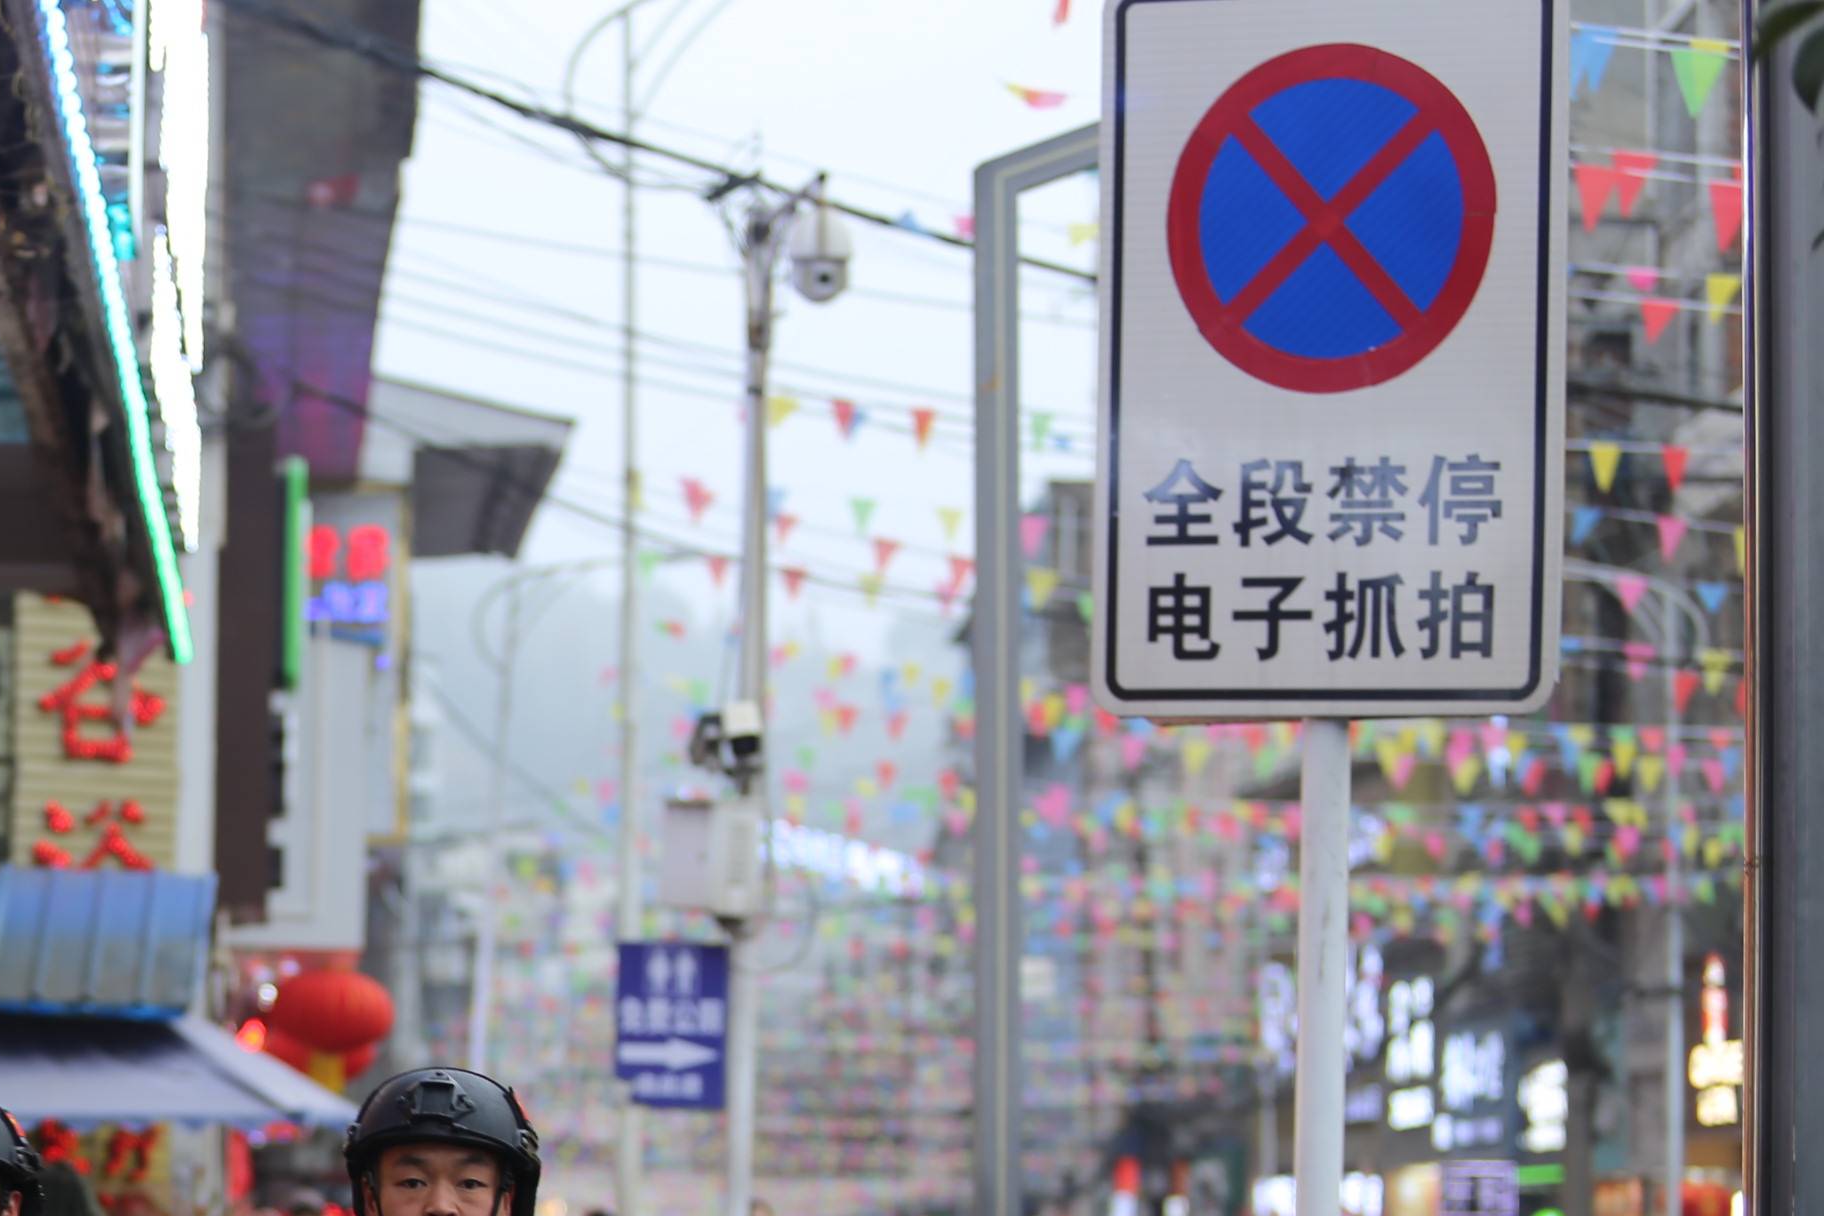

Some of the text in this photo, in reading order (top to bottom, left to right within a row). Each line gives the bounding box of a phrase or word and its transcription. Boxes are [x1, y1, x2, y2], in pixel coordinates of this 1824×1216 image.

[1143, 454, 1502, 546] 全段禁停
[1146, 571, 1494, 662] 电子抓拍
